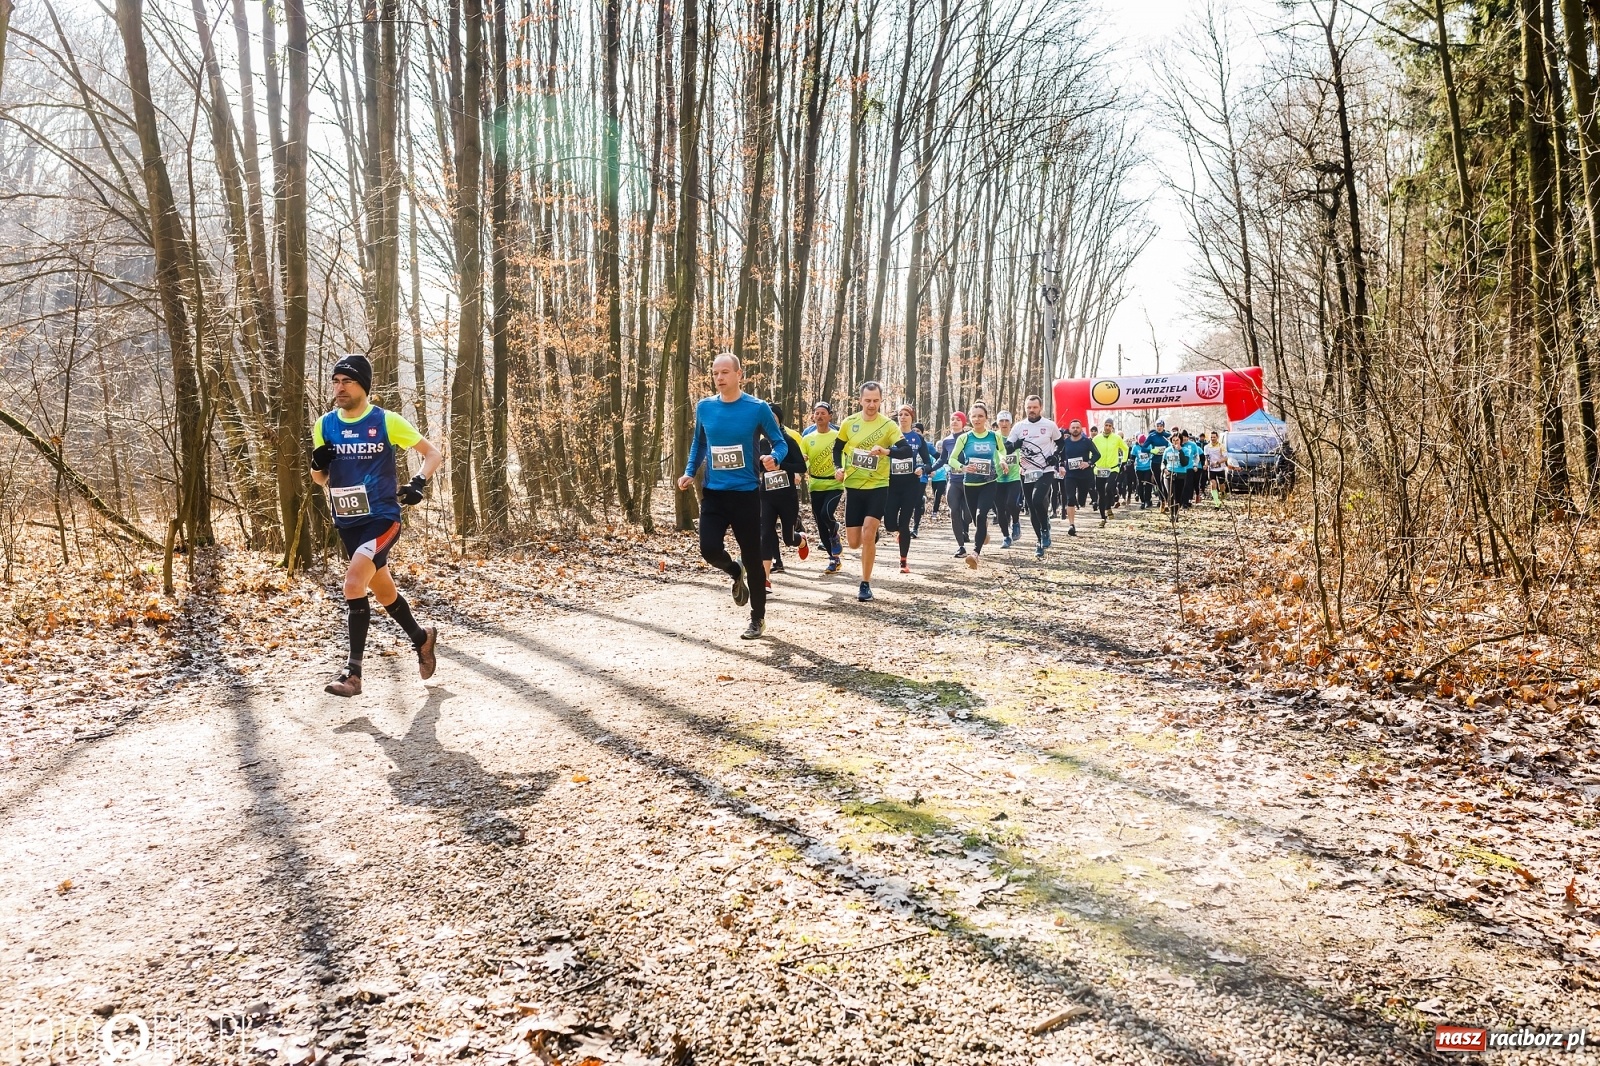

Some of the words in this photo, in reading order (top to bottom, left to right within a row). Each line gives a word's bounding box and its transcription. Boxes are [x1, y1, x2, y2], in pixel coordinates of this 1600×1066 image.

[1125, 385, 1188, 395] TWARDZIELA
[1133, 395, 1182, 404] RACIBÓRZ
[333, 442, 385, 454] NNERS
[717, 453, 737, 463] 089
[856, 455, 873, 465] 079
[976, 463, 987, 471] 92
[768, 475, 784, 485] 044
[338, 496, 360, 509] 018
